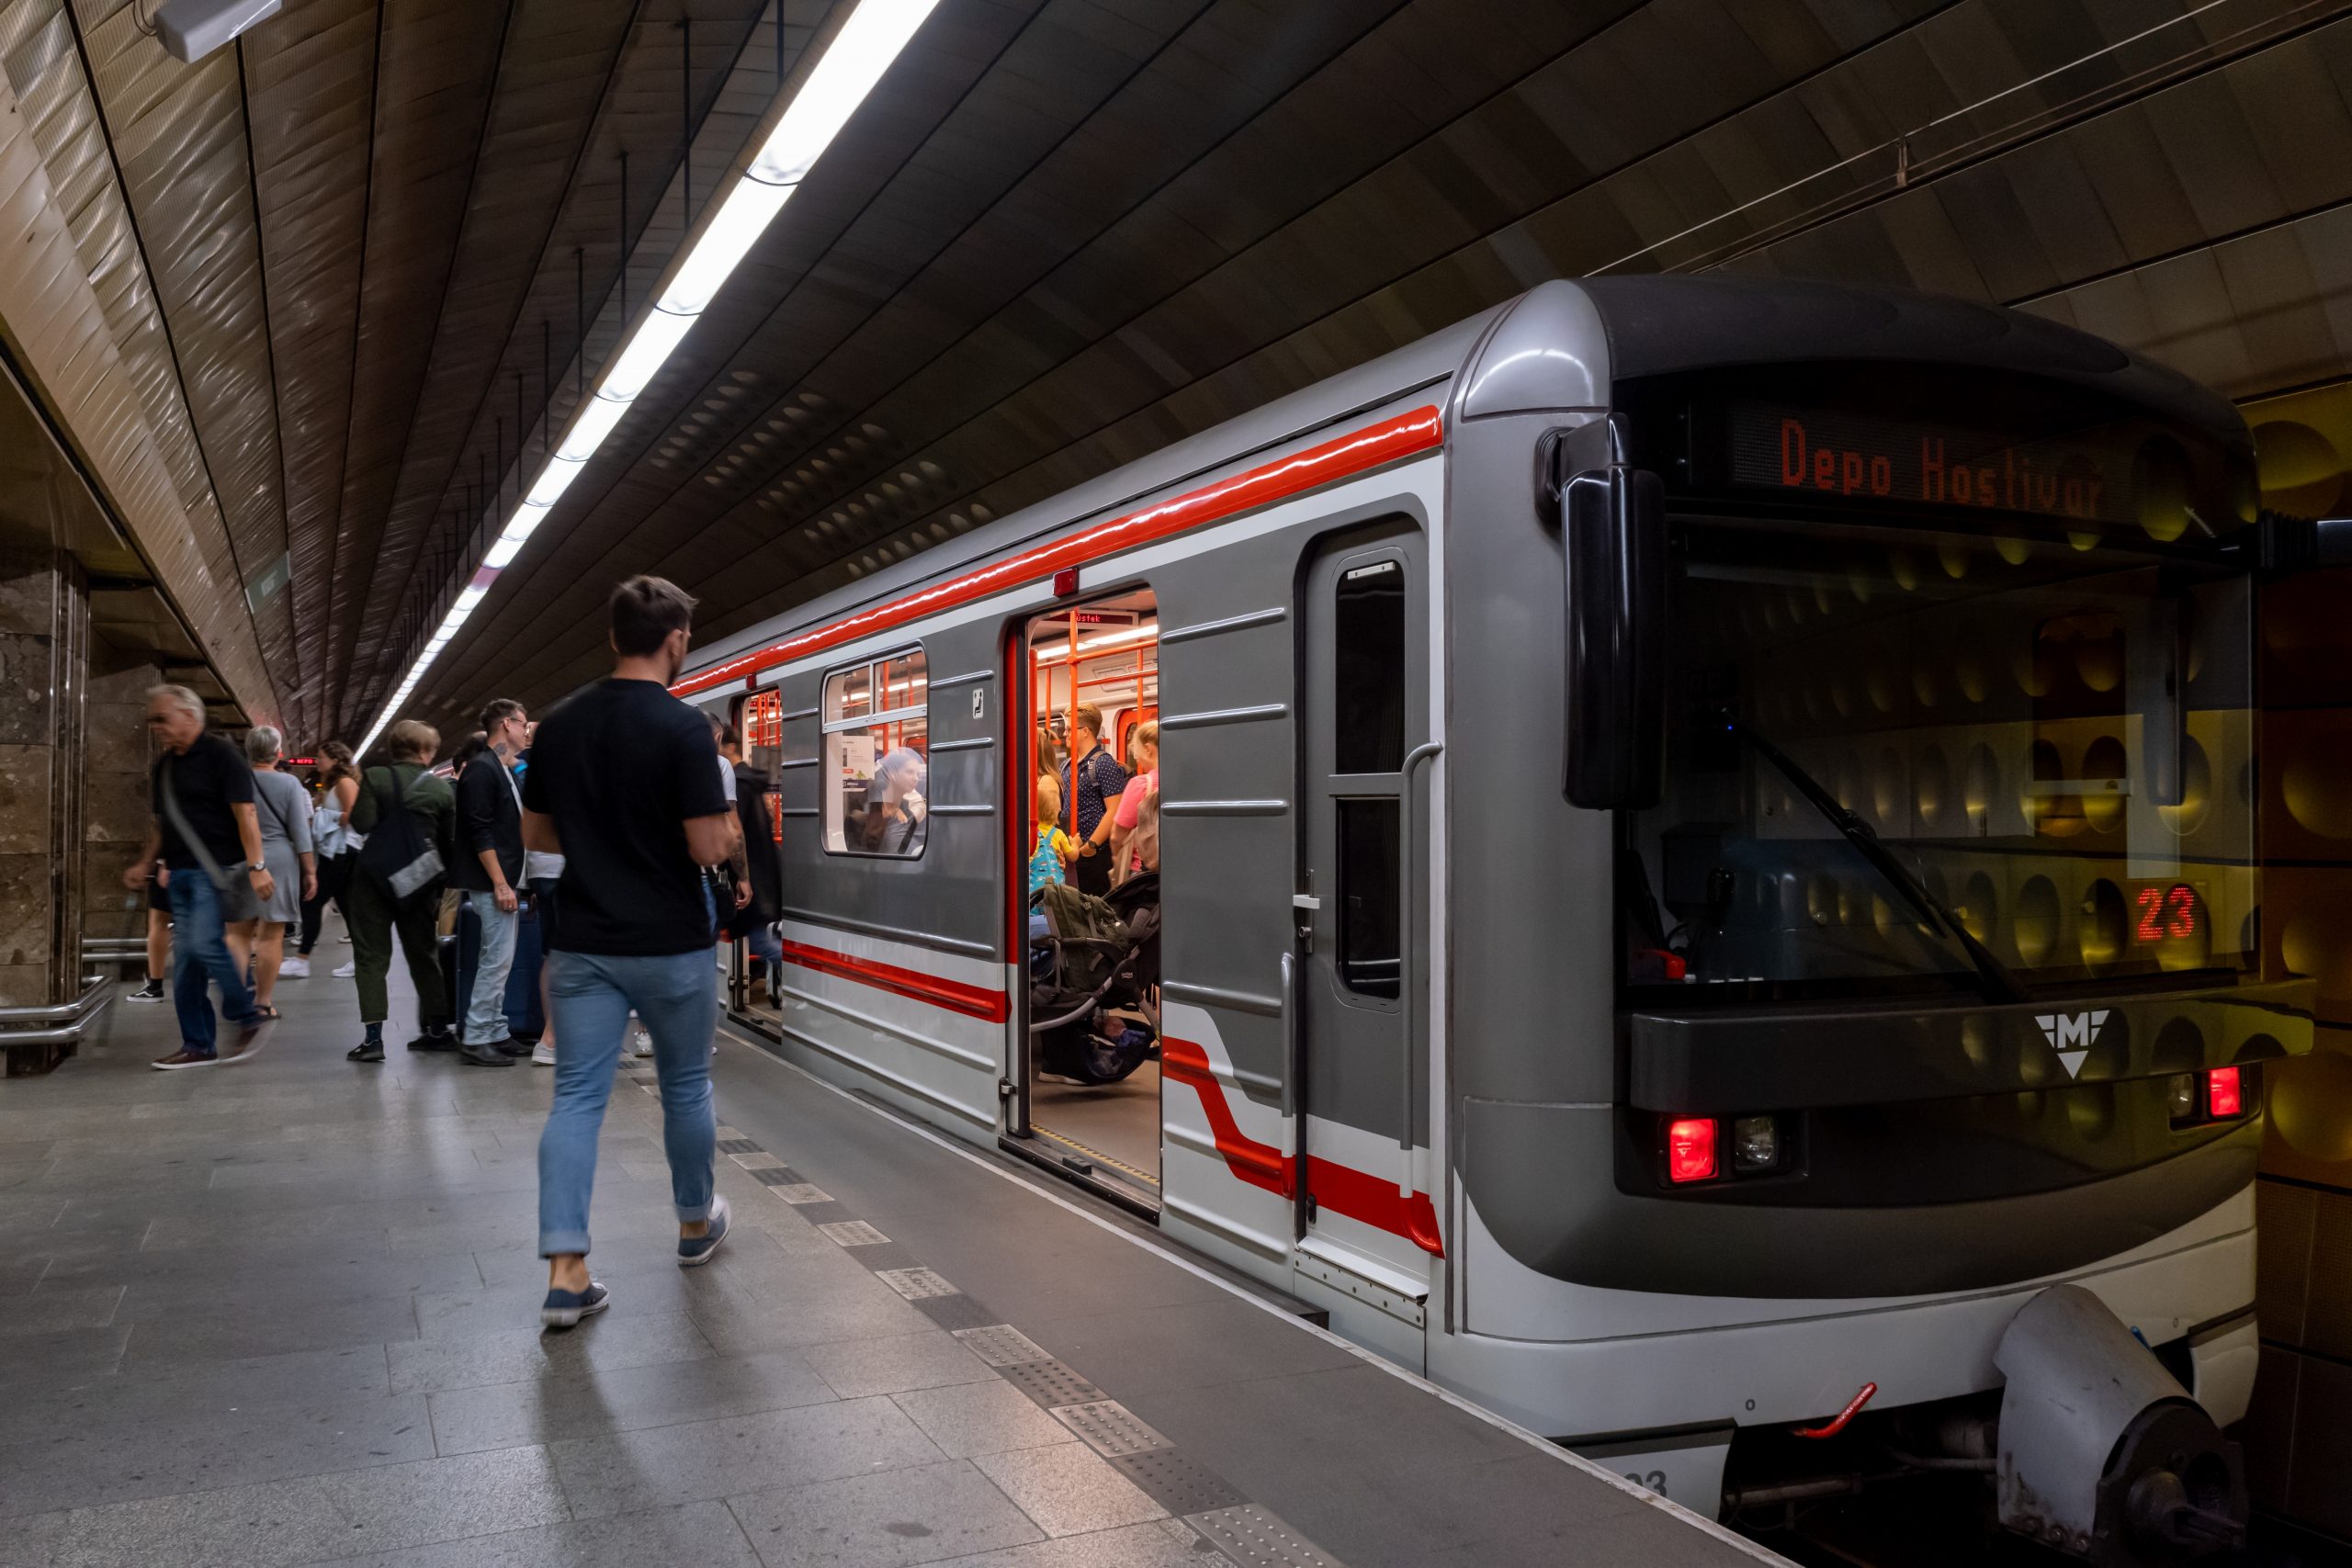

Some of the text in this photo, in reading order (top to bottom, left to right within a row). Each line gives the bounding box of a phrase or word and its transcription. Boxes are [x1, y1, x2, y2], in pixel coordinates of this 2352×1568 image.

[1781, 417, 1892, 497] Depo
[1075, 613, 1102, 623] ůstek
[2137, 886, 2195, 941] 23
